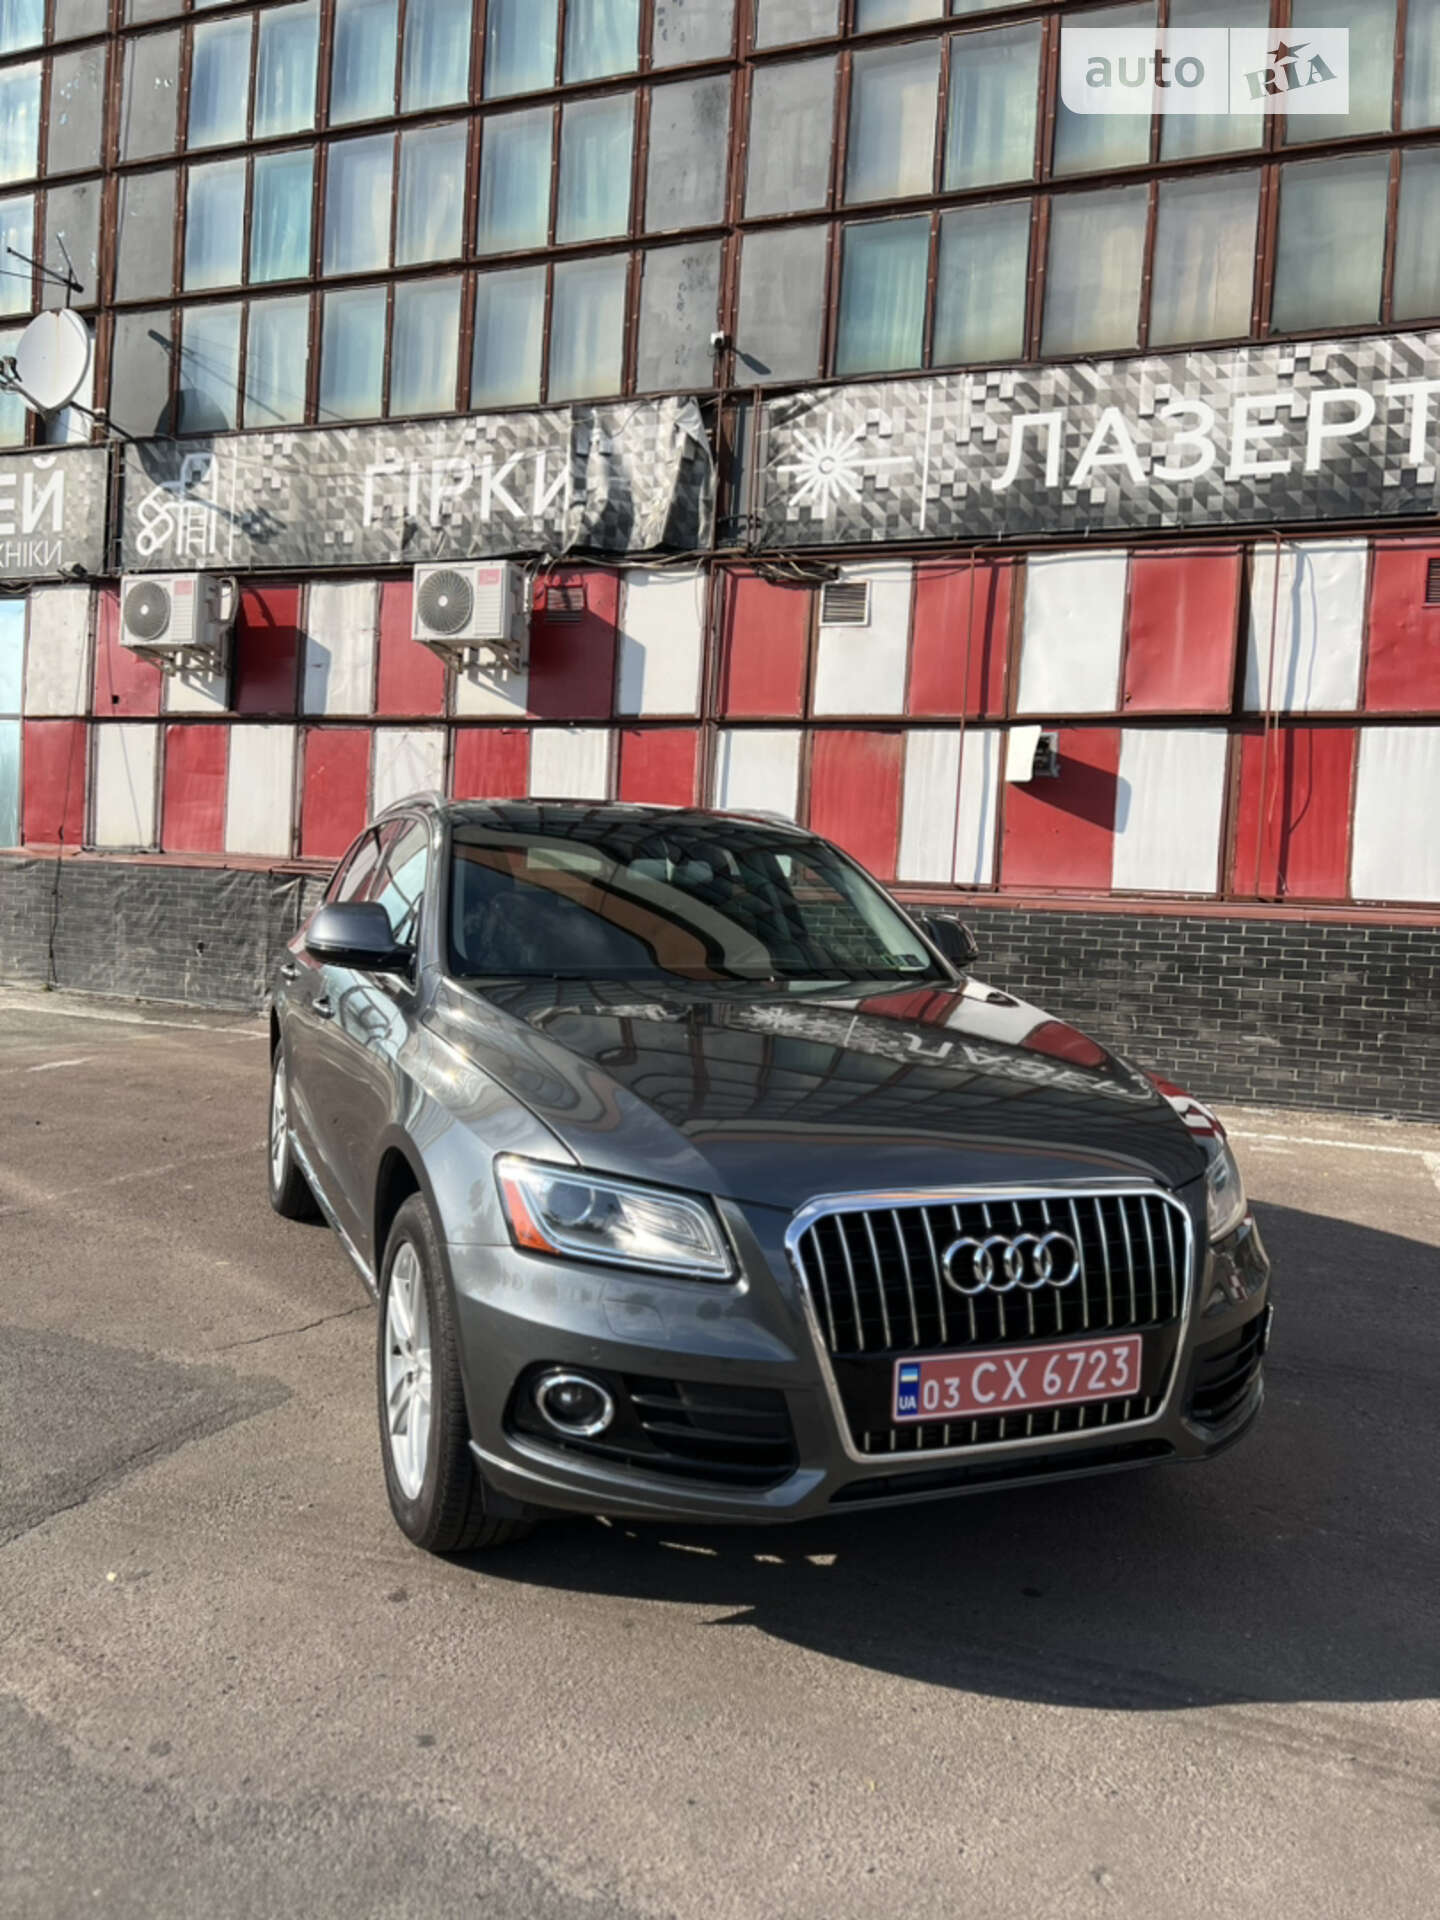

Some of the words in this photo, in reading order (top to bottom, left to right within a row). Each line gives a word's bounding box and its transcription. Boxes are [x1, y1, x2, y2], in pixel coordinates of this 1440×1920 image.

[991, 379, 1440, 491] ЛАЗЕРТ
[362, 448, 572, 528] ГІРКИ
[898, 1395, 918, 1411] UA
[923, 1377, 960, 1411] 03
[971, 1357, 1029, 1404] CX
[1042, 1346, 1130, 1396] 6723
